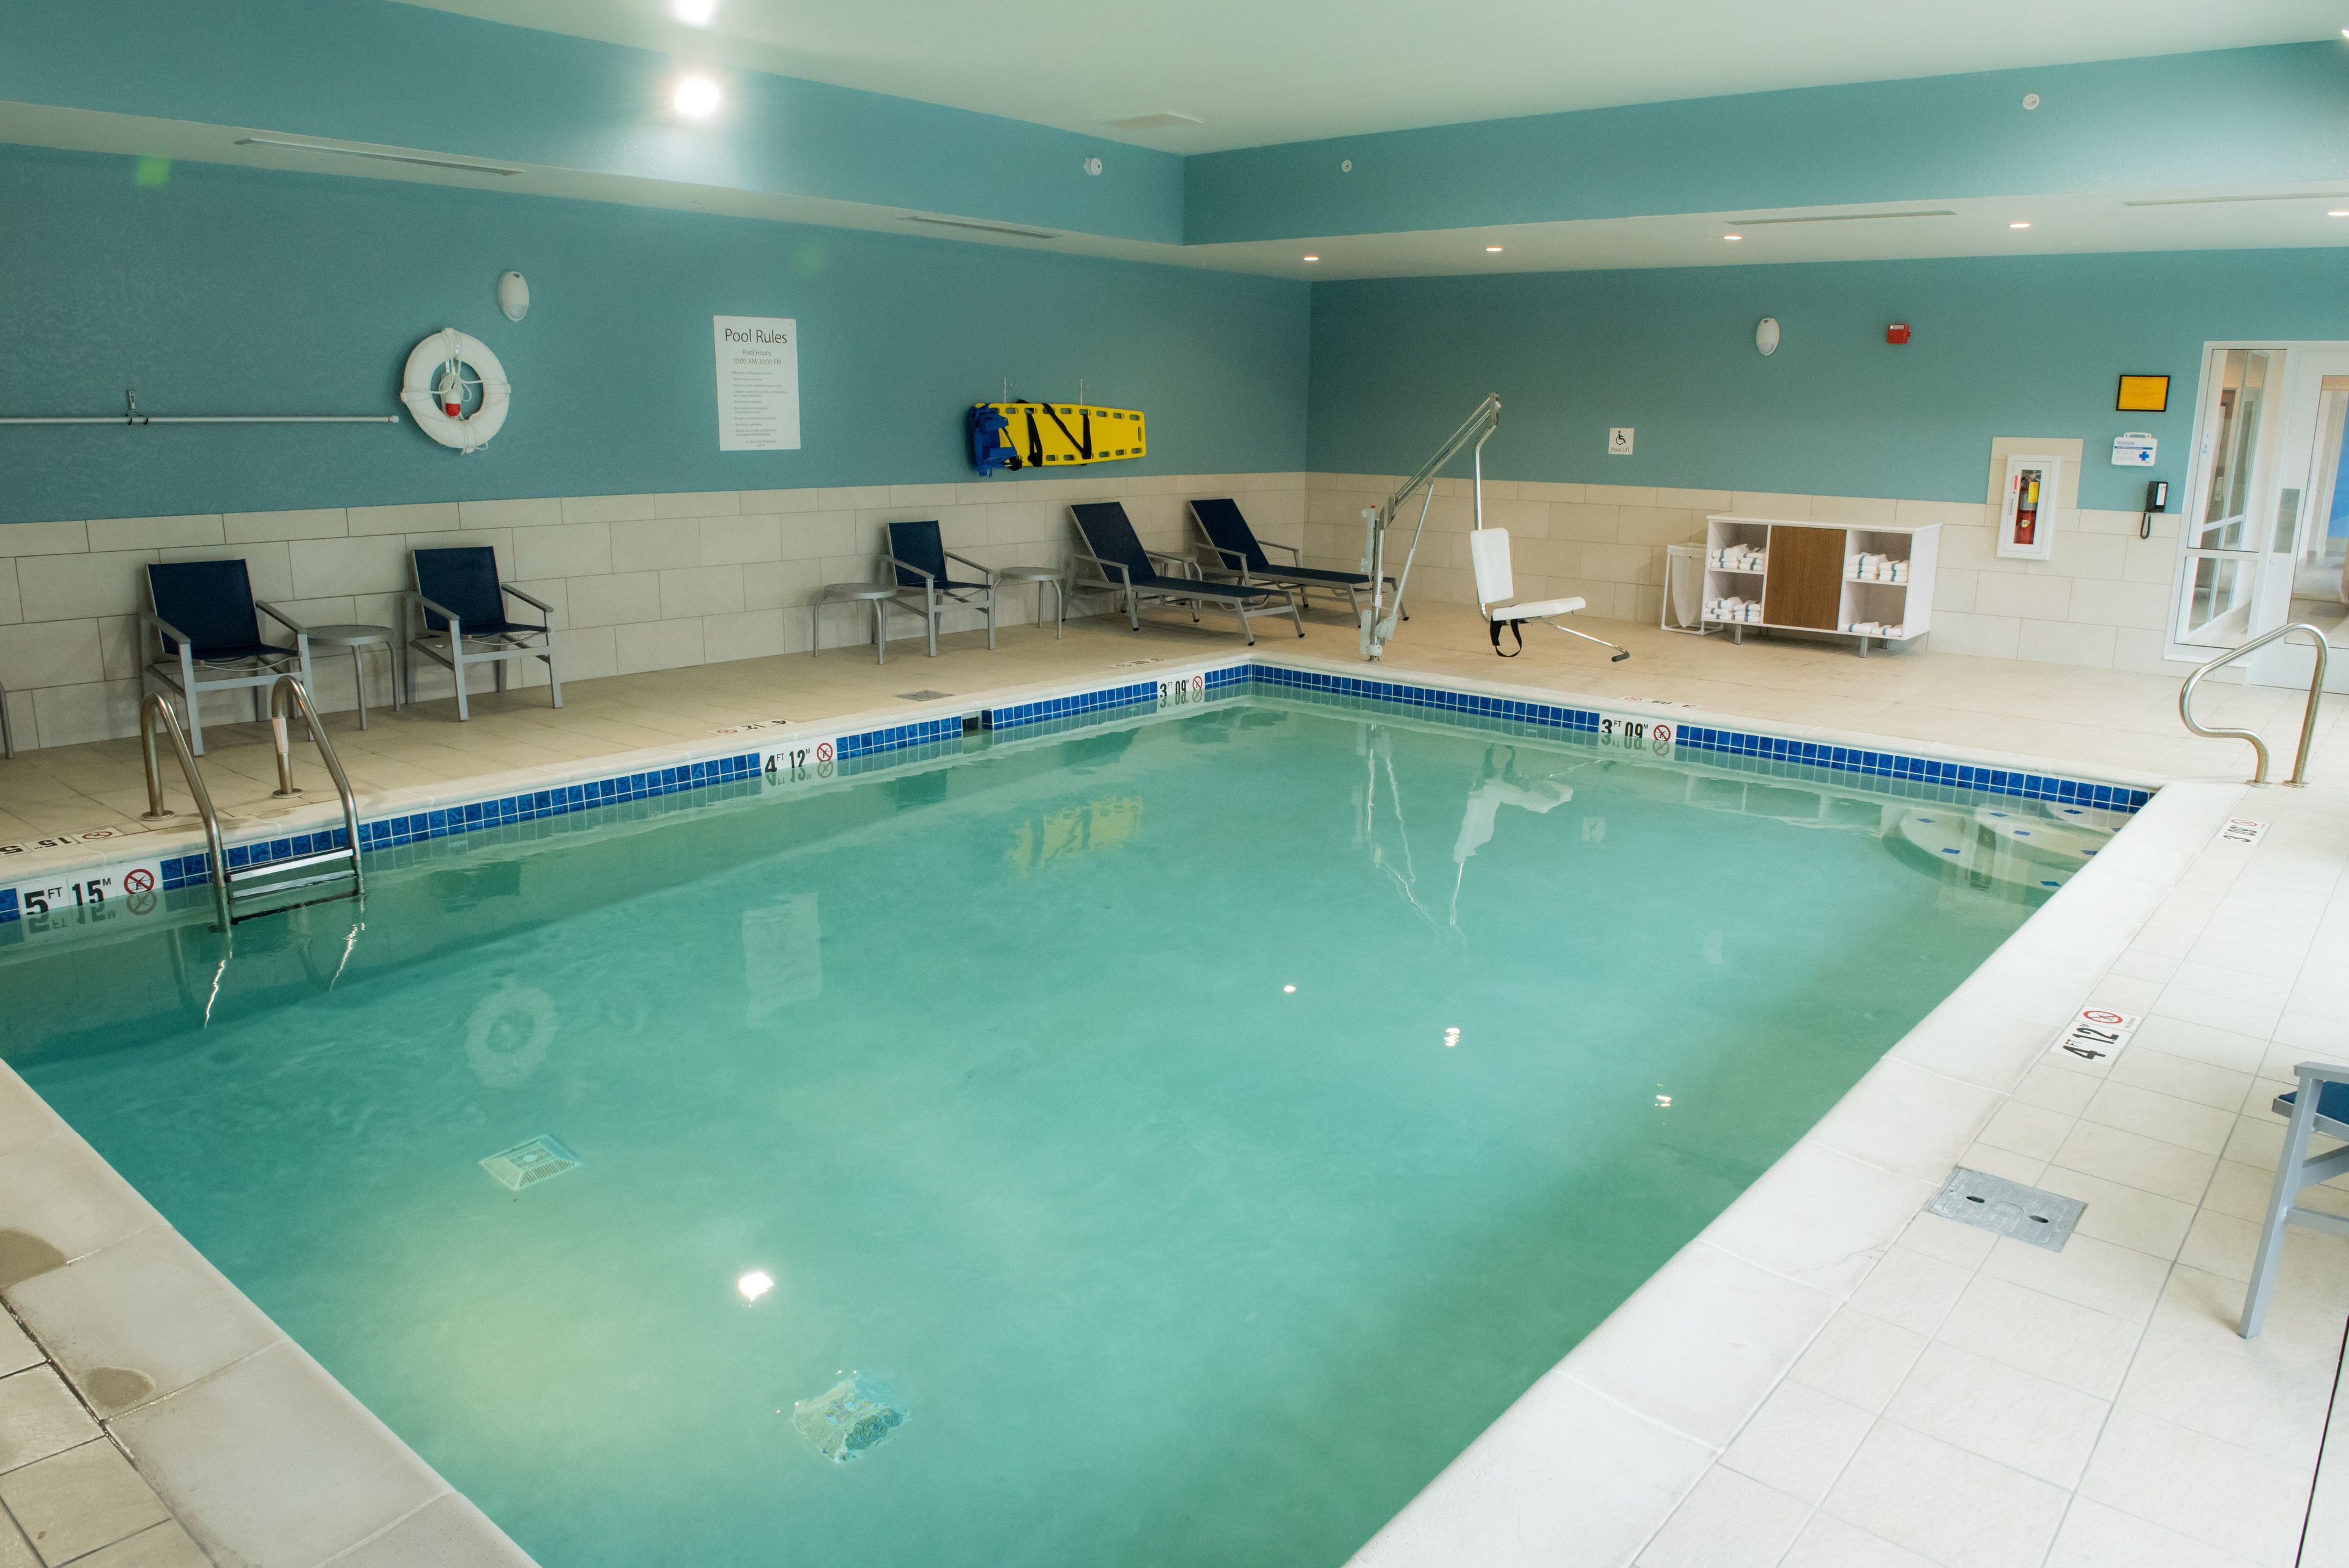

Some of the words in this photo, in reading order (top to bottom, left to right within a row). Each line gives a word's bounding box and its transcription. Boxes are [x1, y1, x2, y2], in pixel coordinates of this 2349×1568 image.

[725, 328, 752, 343] Pool
[756, 329, 787, 344] Rules
[1159, 683, 1168, 697] 3
[1600, 718, 1612, 734] 3
[765, 754, 777, 773] 4
[776, 752, 785, 762] FT
[24, 890, 49, 915] 5
[47, 886, 62, 899] FT
[102, 877, 112, 886] M
[2065, 1039, 2082, 1047] FT
[2062, 1045, 2106, 1060] 4
